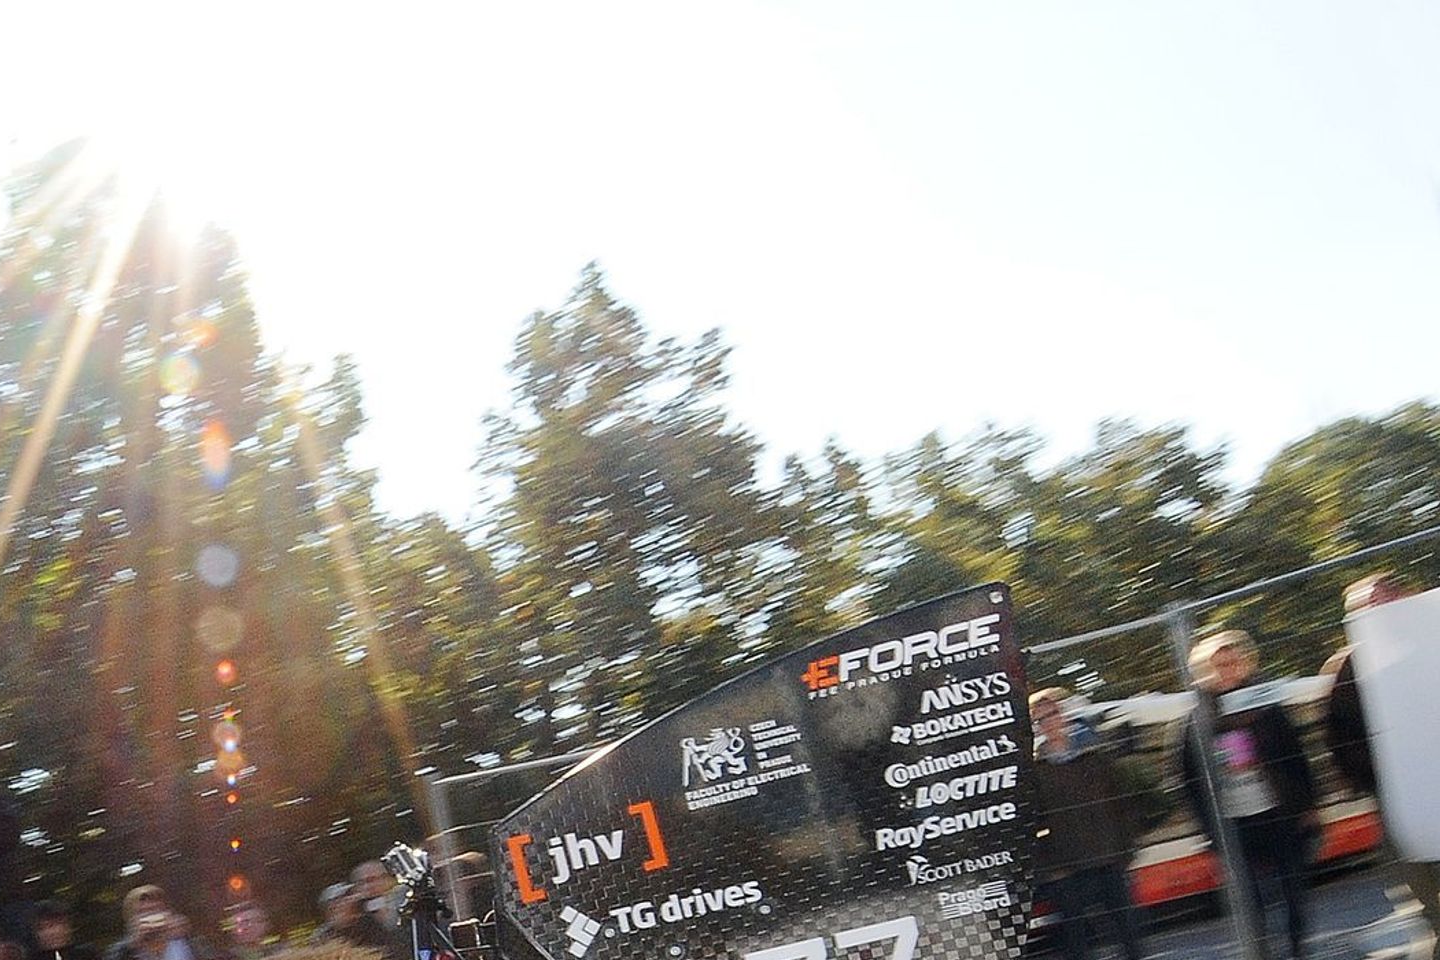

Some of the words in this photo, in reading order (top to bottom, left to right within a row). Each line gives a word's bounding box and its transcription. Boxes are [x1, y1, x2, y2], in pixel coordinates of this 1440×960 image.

[846, 666, 913, 691] PRAGUE
[921, 644, 1000, 671] FORMULA
[920, 672, 1010, 714] ANSYS
[911, 701, 1013, 740] BOKATECH
[685, 782, 730, 801] FACULTY
[731, 778, 746, 790] OF
[747, 763, 811, 786] ELECTRICAL
[884, 738, 1000, 788] Continental
[915, 765, 1018, 809] LOCTITE
[875, 802, 1016, 850] RayService
[917, 861, 963, 885] SCOTT
[964, 851, 1014, 872] BADER
[610, 901, 657, 934] TG
[661, 880, 762, 924] drives
